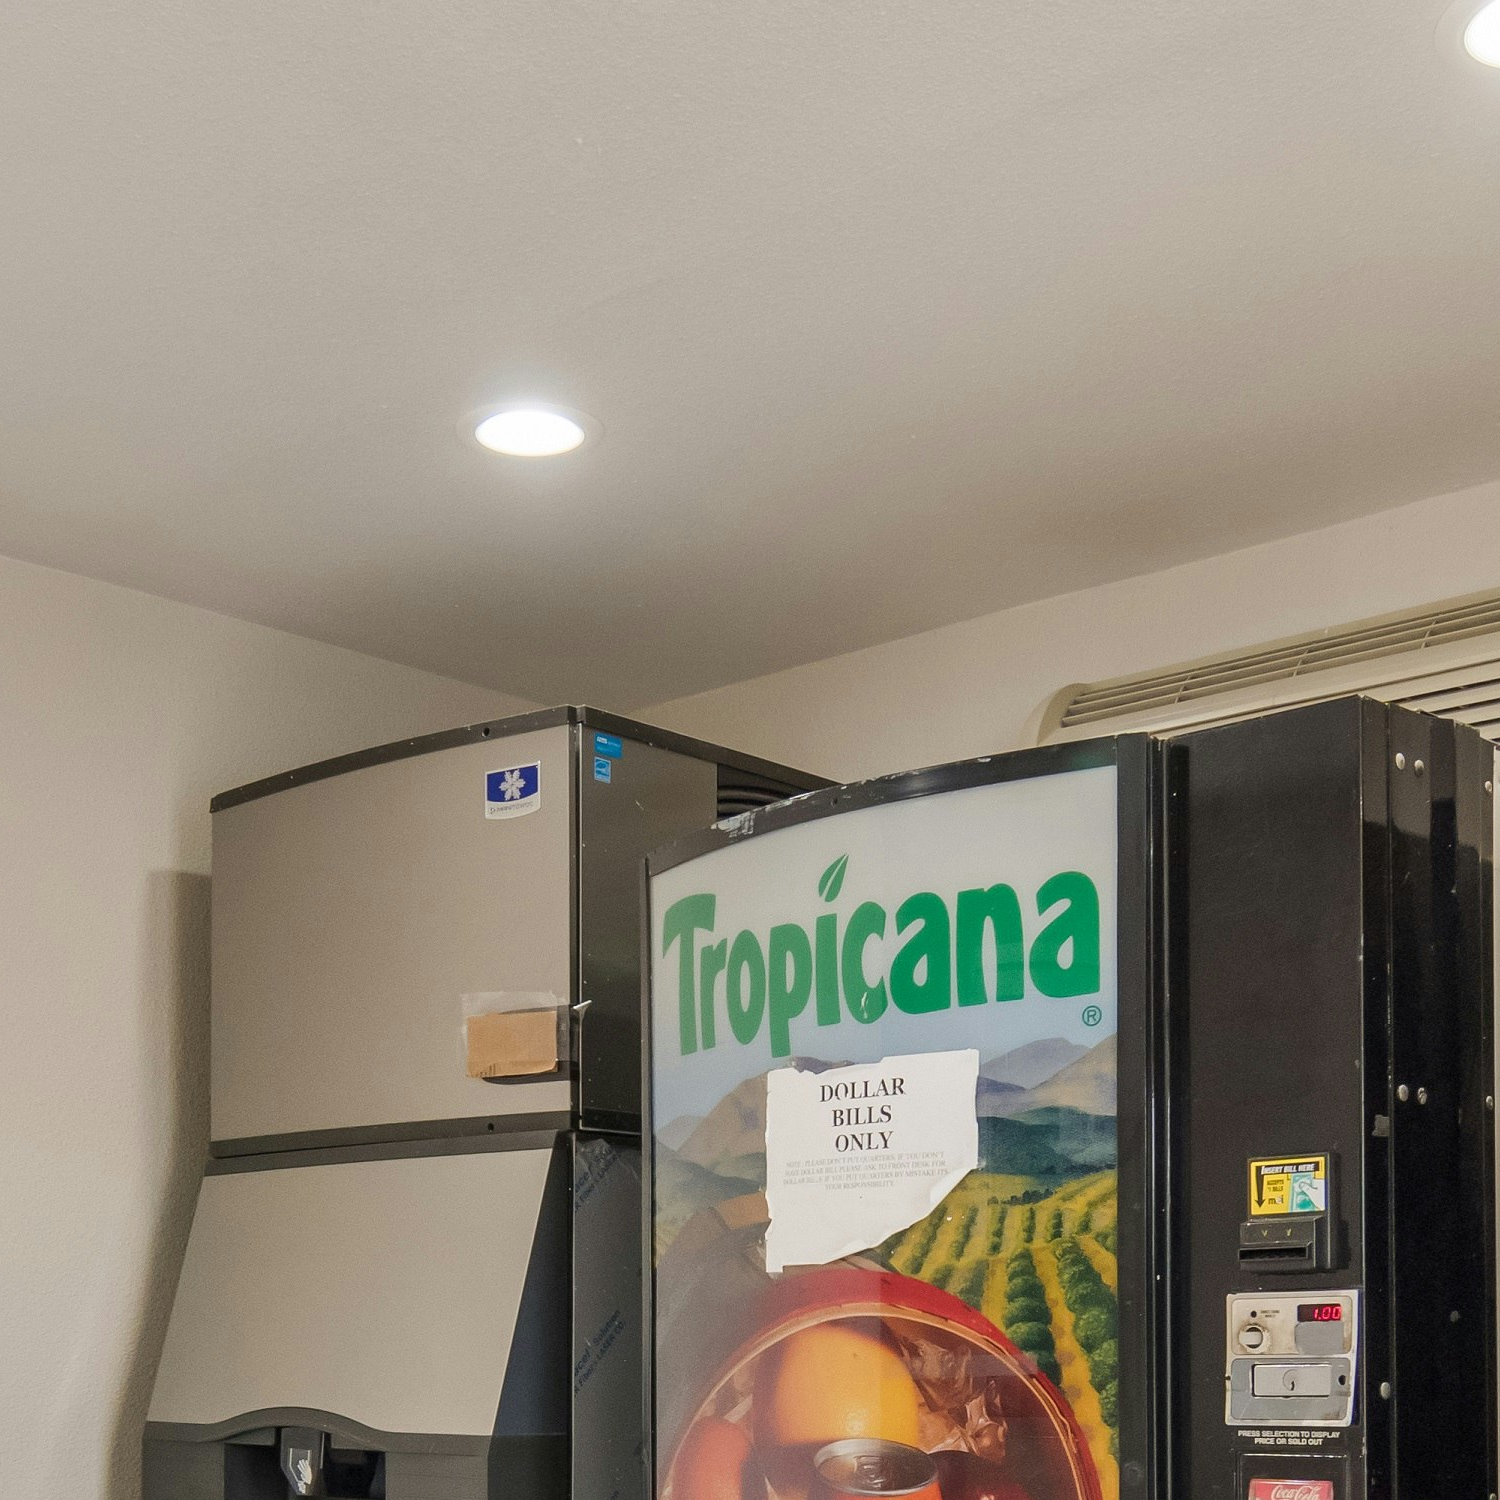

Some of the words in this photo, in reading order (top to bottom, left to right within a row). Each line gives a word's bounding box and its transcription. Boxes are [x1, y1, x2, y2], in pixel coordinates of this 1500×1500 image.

[662, 853, 1101, 1058] Tropicana
[820, 1077, 906, 1102] DOLLAR
[832, 1105, 892, 1127] BILLS
[835, 1131, 894, 1153] ONLY
[1313, 1306, 1341, 1320] 1.00
[1261, 1430, 1300, 1438] SELECTION
